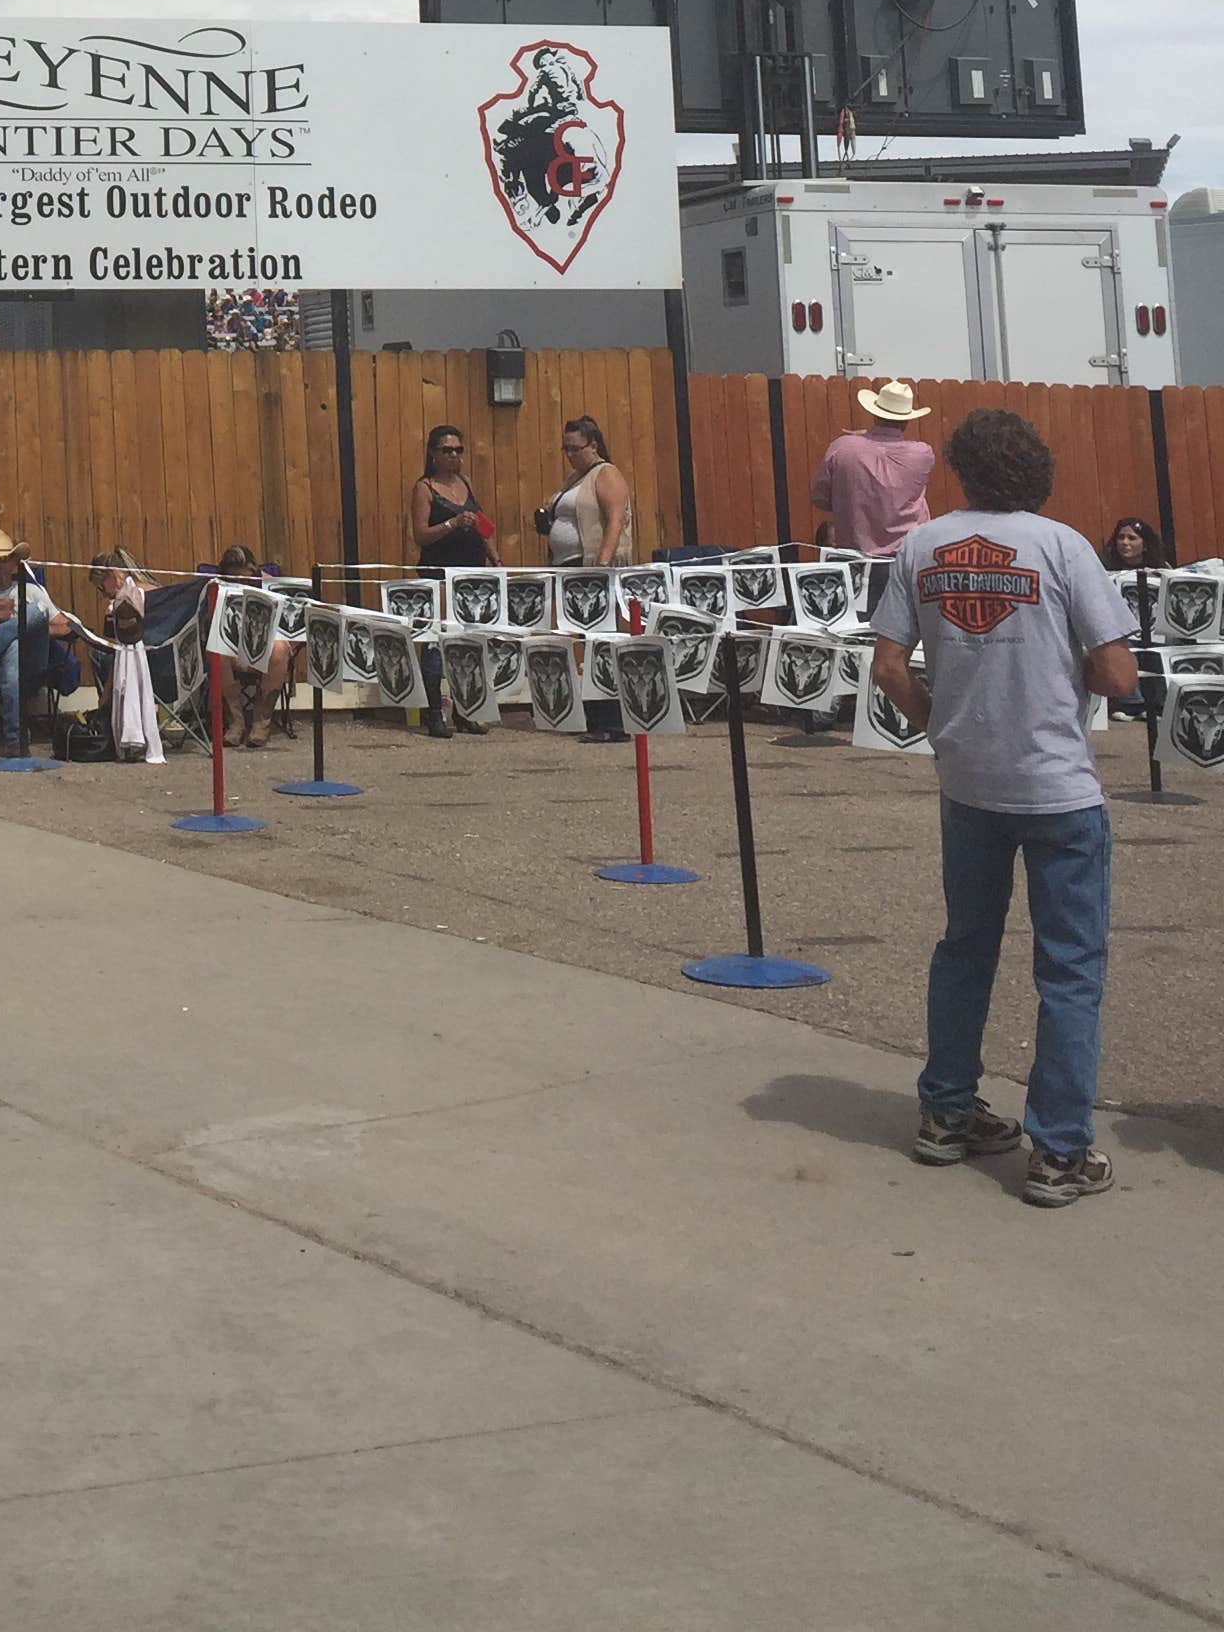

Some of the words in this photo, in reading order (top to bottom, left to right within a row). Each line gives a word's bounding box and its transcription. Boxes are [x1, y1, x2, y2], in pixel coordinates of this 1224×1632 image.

[106, 184, 252, 219] Outdoor
[267, 185, 377, 219] Rodeo
[89, 246, 303, 280] Celebration
[944, 542, 1003, 566] MOTOR
[922, 572, 1031, 595] HARLEY-DAVIDSON
